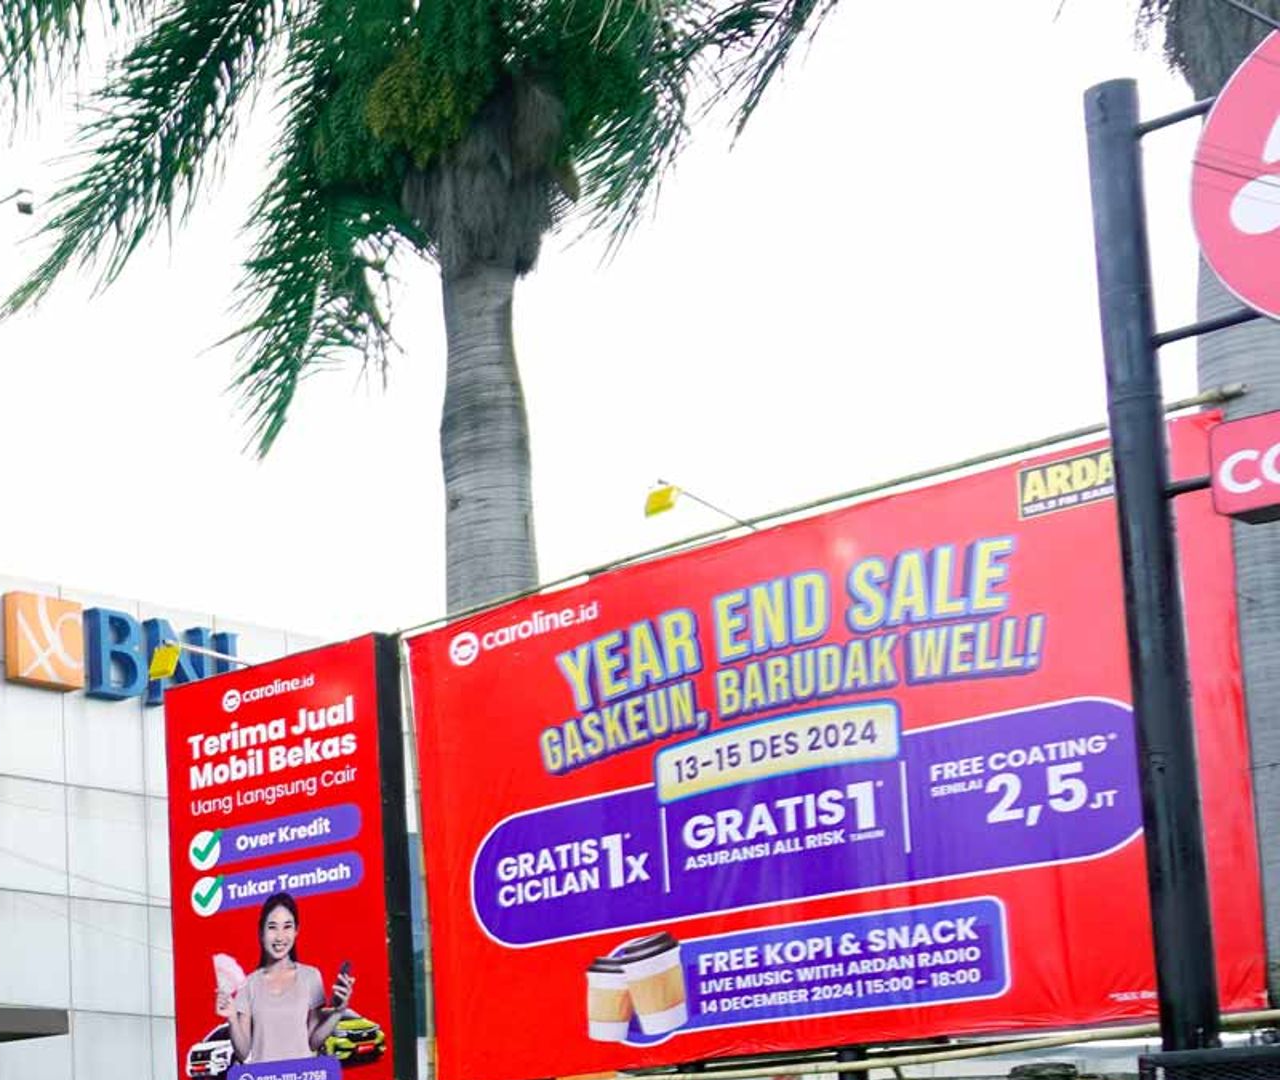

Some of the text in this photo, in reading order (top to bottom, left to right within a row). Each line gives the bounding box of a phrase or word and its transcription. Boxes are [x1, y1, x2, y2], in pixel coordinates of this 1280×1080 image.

[481, 601, 599, 650] caroline.id
[555, 535, 1016, 712] YEAR END SALE
[242, 673, 315, 703] caroline.id
[540, 614, 1045, 775] GASKEUN, BARUDAK WELL!
[187, 695, 355, 760] Terima Jual
[674, 721, 878, 783] 13-15 DES 2024
[189, 733, 358, 790] Mobil Bekas
[930, 756, 984, 782] FREE
[191, 765, 358, 817] Uang Langsung Cair
[985, 761, 1088, 827] 2,5
[1090, 789, 1120, 809] JT
[236, 817, 331, 850] Over Kredit
[683, 788, 846, 850] GRATIS
[497, 839, 599, 881] GRATIS
[684, 845, 770, 871] ASURANSI
[772, 838, 804, 857] ALL
[806, 829, 845, 848] RISK
[227, 863, 351, 899] Tukar Tambah
[498, 868, 600, 908] CICILAN
[698, 916, 979, 976] FREE KOPI & SNACK
[700, 946, 982, 995] LIVE MUSIC WITH ARDAN RADIO
[700, 1000, 718, 1014] 14
[720, 988, 809, 1013] DECEMBER
[812, 984, 854, 1001] 2024
[865, 975, 914, 994] 15:00
[930, 968, 982, 987] 18:00
